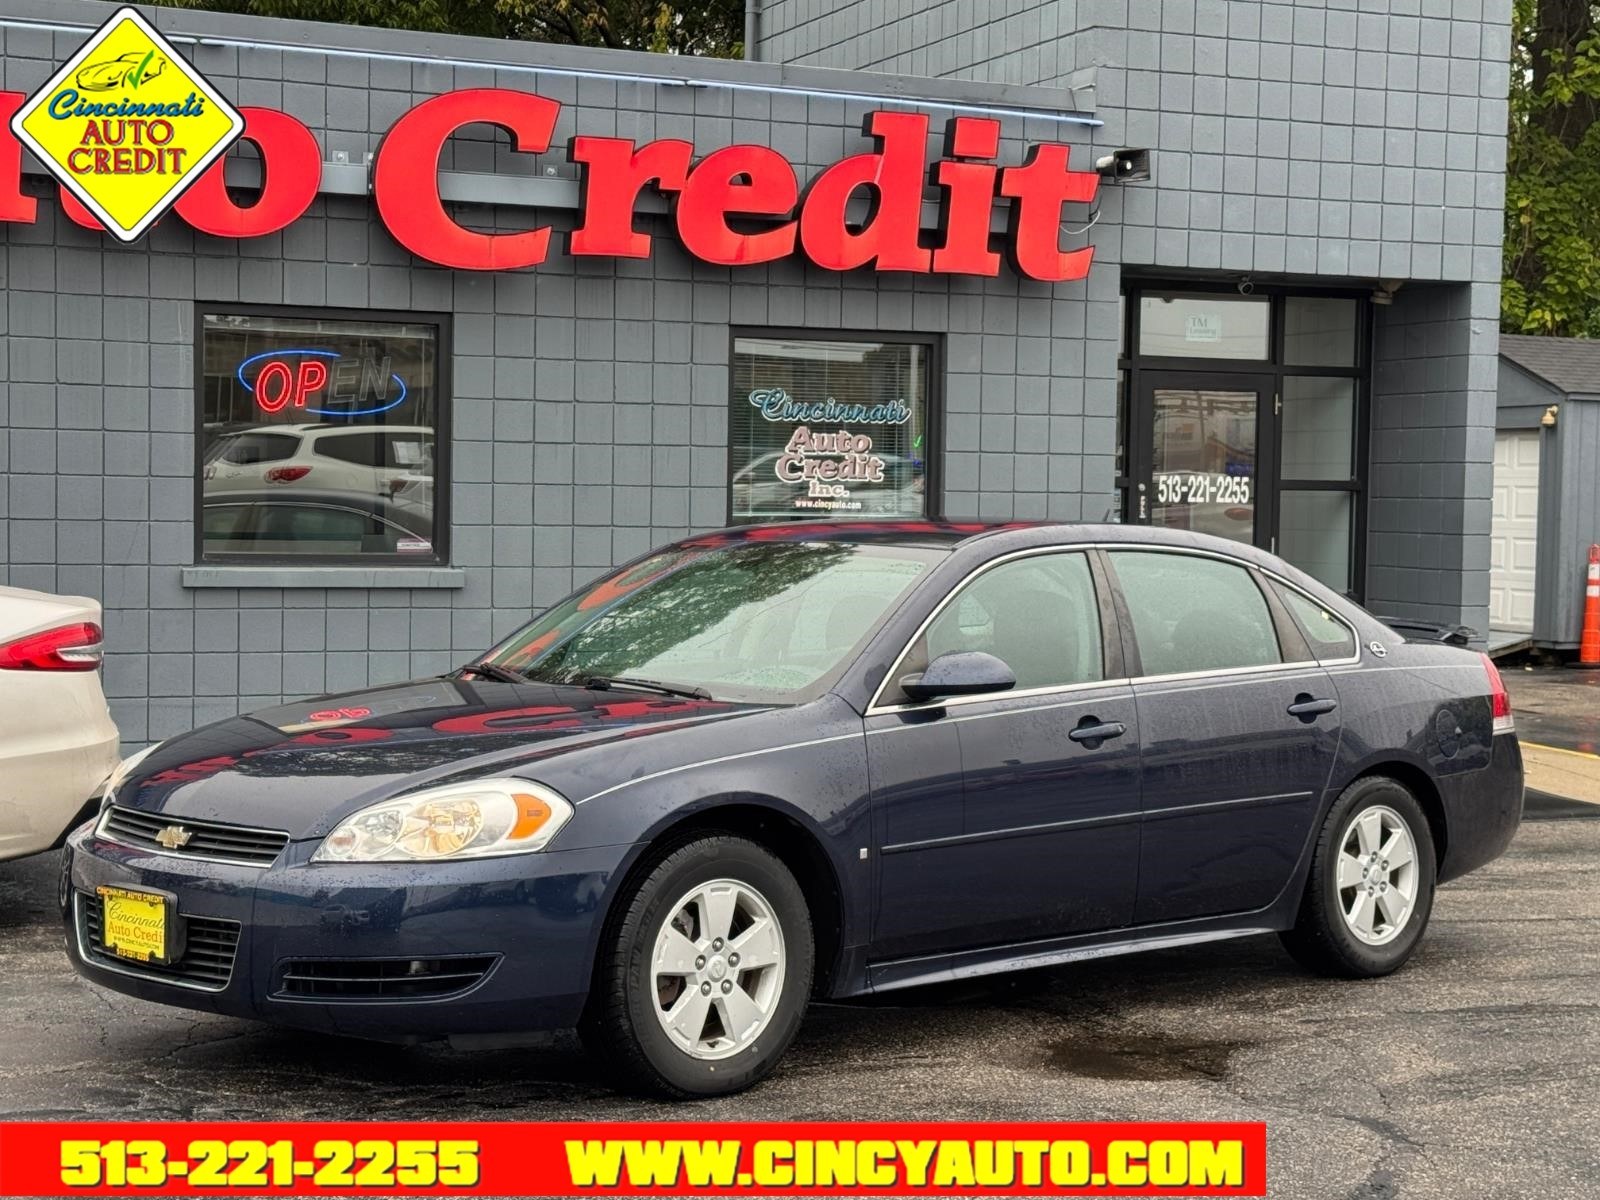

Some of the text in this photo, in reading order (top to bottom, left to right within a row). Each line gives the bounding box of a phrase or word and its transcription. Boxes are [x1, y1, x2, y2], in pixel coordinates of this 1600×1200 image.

[373, 87, 1099, 282] Credit
[255, 356, 391, 412] OPEN
[749, 388, 912, 424] Cincinnati
[785, 425, 872, 455] Auto
[775, 454, 885, 483] Credit
[808, 480, 850, 497] Inc.
[1157, 475, 1250, 503] 513-221-2255
[794, 499, 862, 510] www.cincyauto.com
[107, 920, 164, 944] Auto Credi
